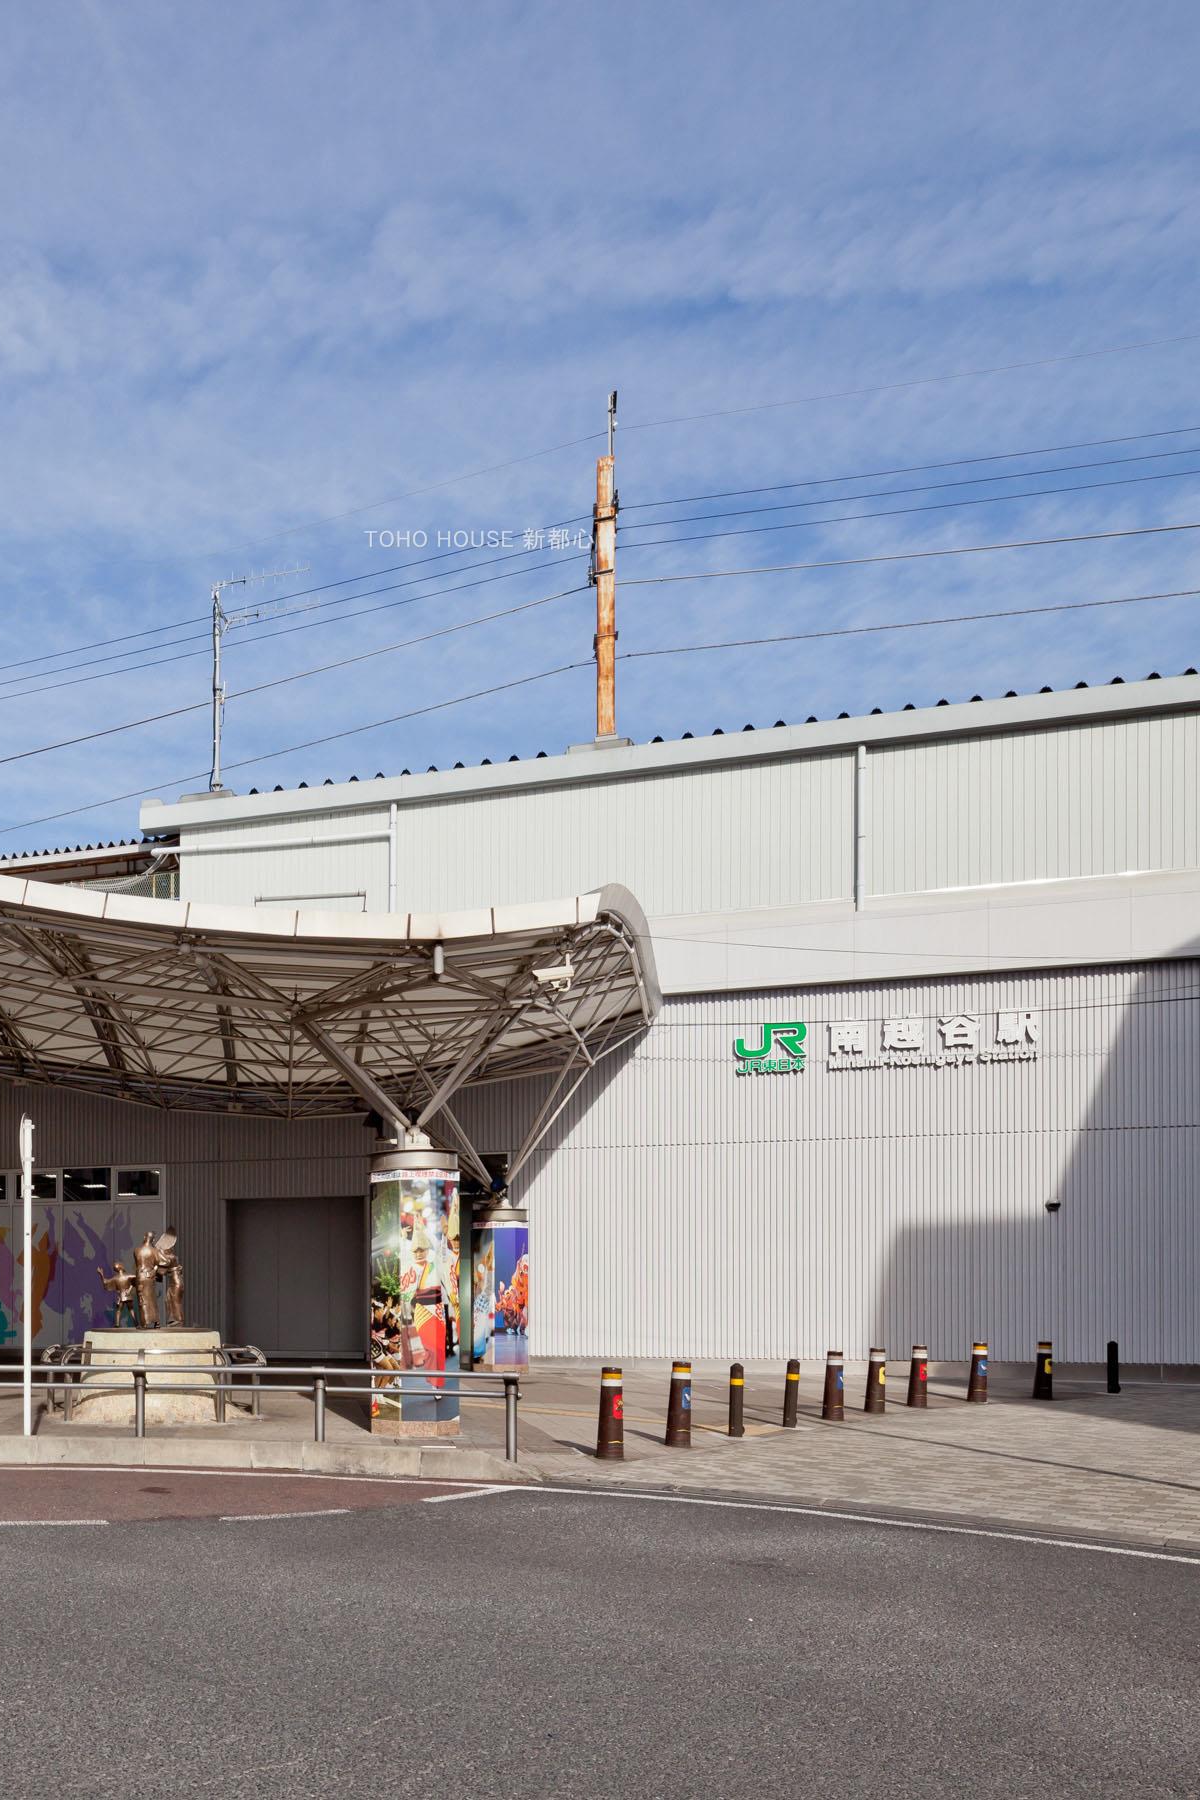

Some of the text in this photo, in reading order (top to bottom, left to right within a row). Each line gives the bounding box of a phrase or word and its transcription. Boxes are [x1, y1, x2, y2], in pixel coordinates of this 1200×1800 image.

[735, 1020, 807, 1059] JR
[827, 1006, 1040, 1054] 南越谷駅
[738, 1057, 806, 1074] JR東日本
[828, 1048, 1038, 1070] Minami-Koshigaya Station
